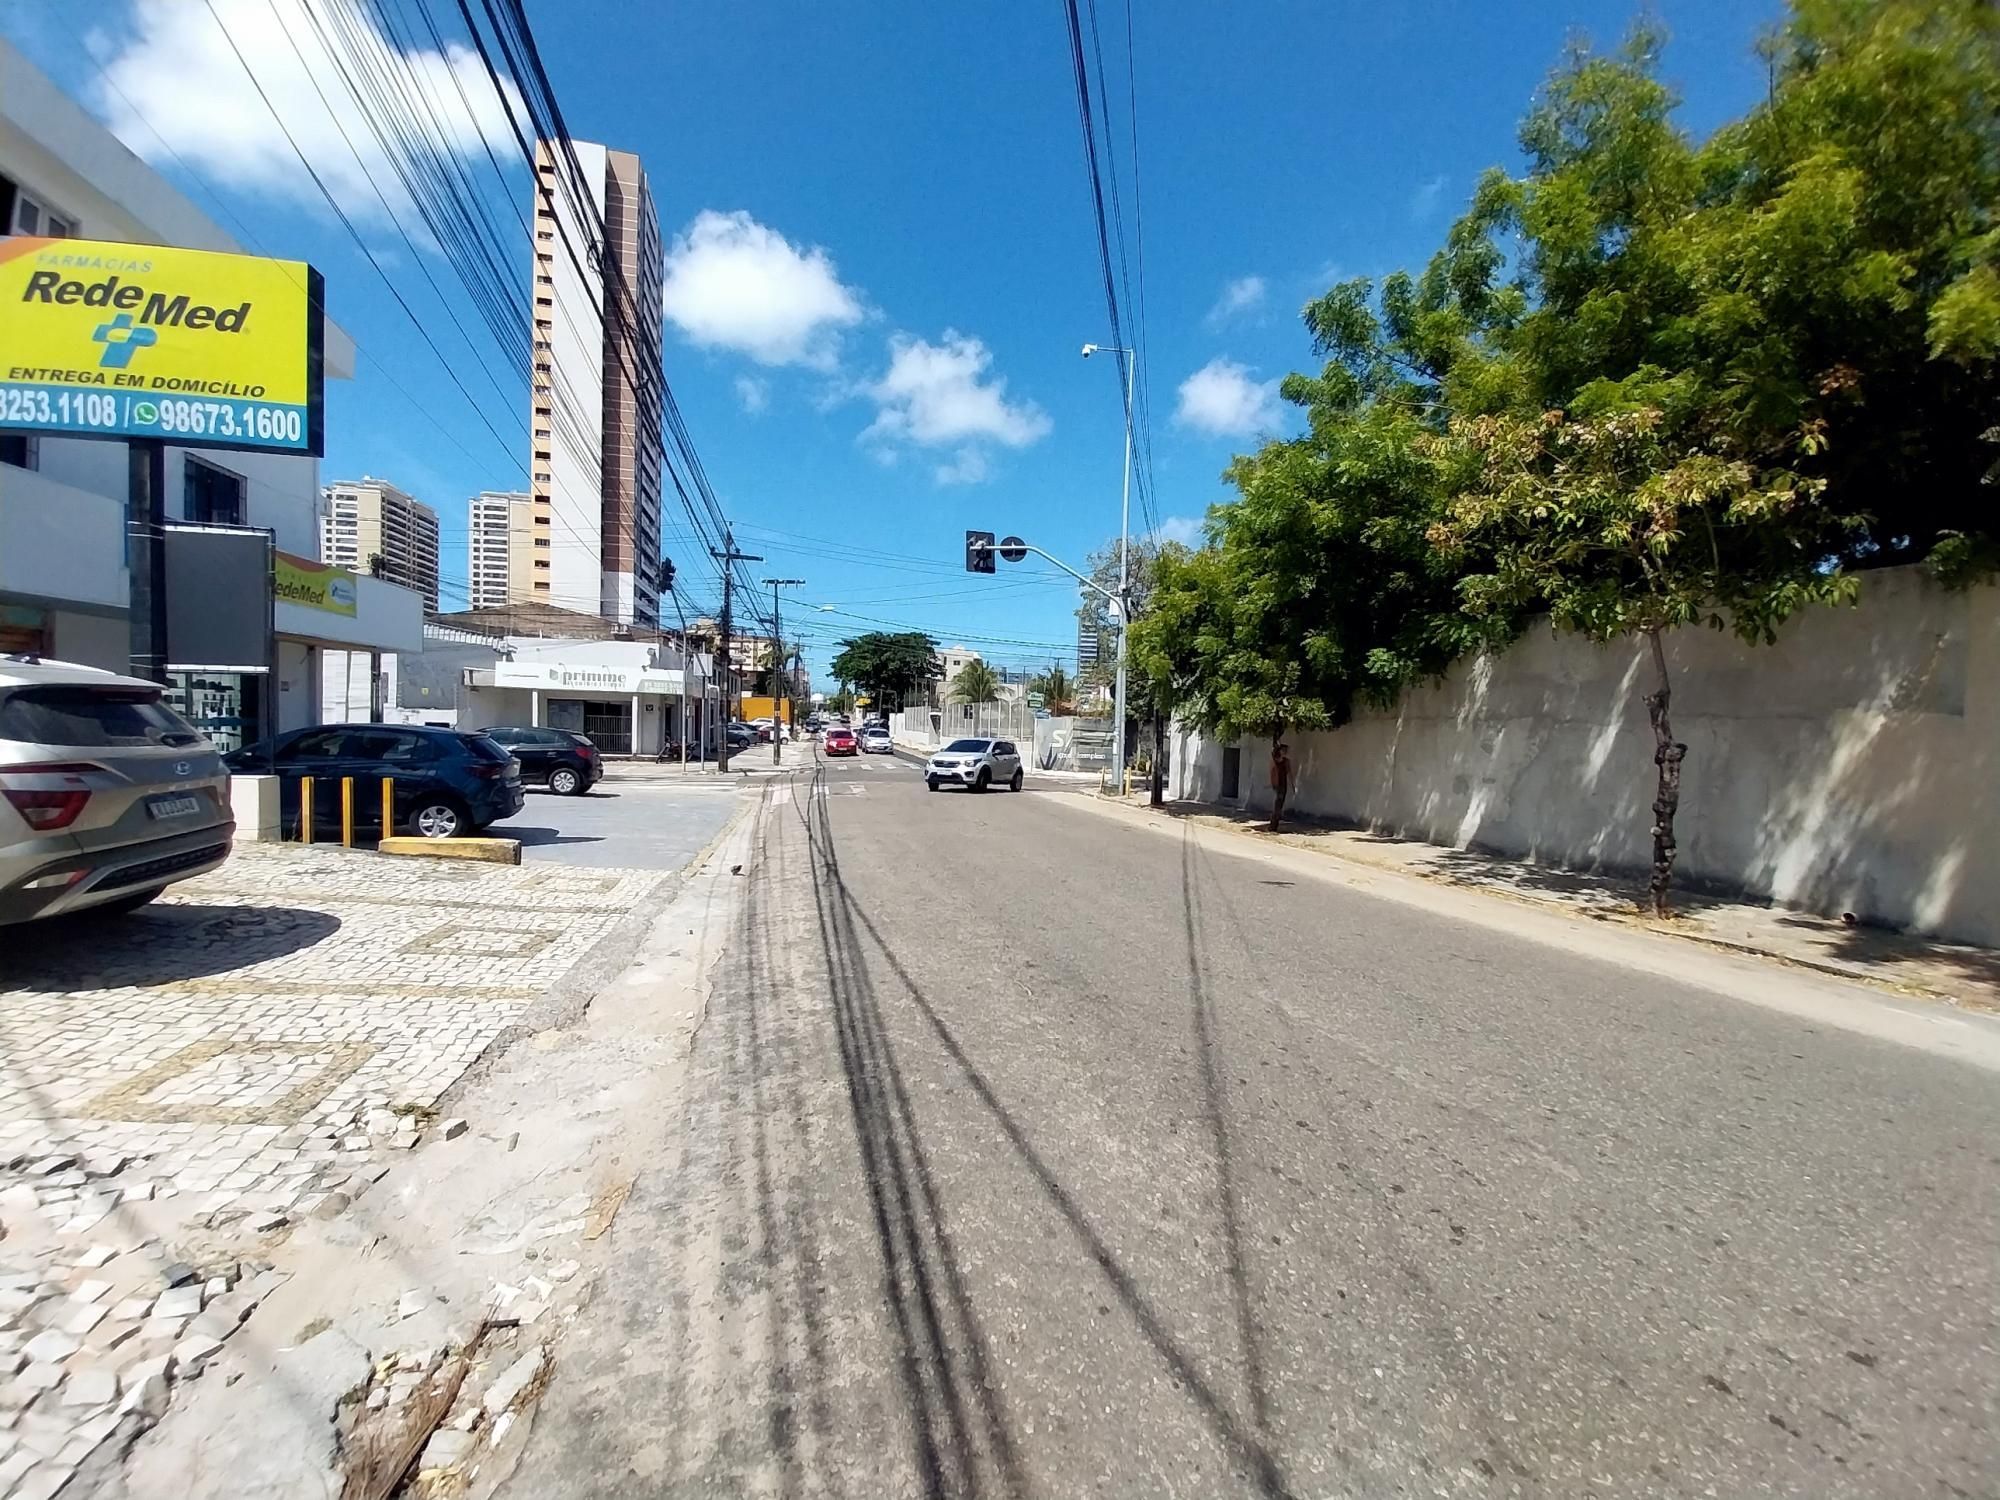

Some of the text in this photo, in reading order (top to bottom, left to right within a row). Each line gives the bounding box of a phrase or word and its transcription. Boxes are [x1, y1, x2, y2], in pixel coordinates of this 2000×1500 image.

[8, 367, 266, 398] ENTREGA EM DOMICÍLIO
[160, 399, 301, 442] 98673.1600
[275, 582, 325, 604] edeMed
[562, 670, 627, 685] primme
